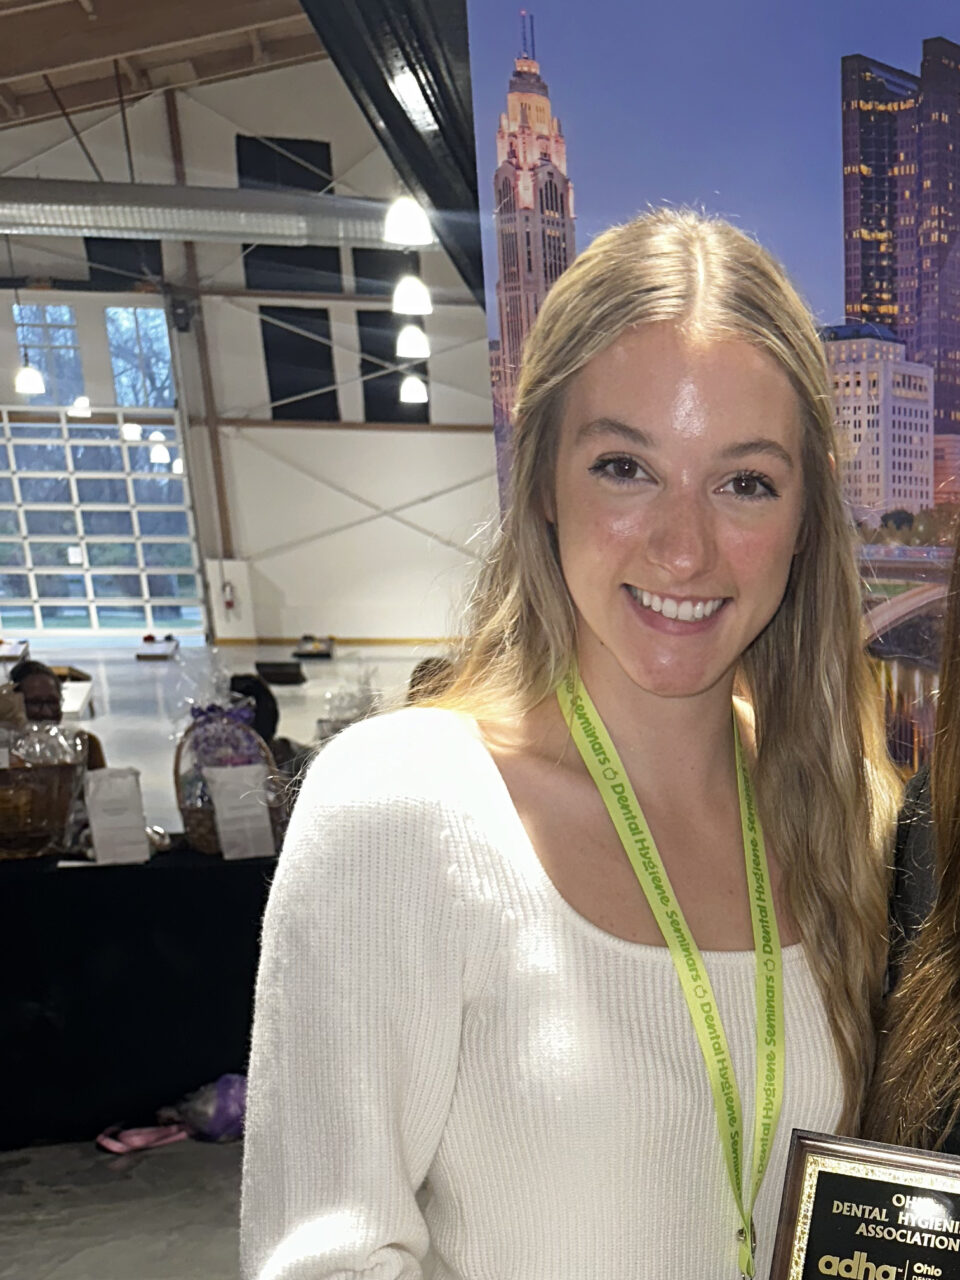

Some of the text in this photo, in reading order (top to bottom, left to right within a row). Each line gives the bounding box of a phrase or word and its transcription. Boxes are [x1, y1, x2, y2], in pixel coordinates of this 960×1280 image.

[750, 838, 766, 903] Hygiene
[570, 695, 611, 766] Seminars
[610, 782, 644, 836] Dental
[634, 838, 670, 907] Hygiene
[665, 909, 702, 983] Seminars
[700, 1001, 725, 1056] Dental
[716, 1057, 738, 1127] Hygiene
[756, 904, 774, 955] Dental
[764, 975, 777, 1048] Seminars
[762, 1050, 776, 1120] Hygiene
[757, 1121, 772, 1175] Dental
[832, 1200, 890, 1222] DENTAL
[856, 1222, 960, 1252] ASSOCIATION
[913, 1261, 943, 1278] Ohio
